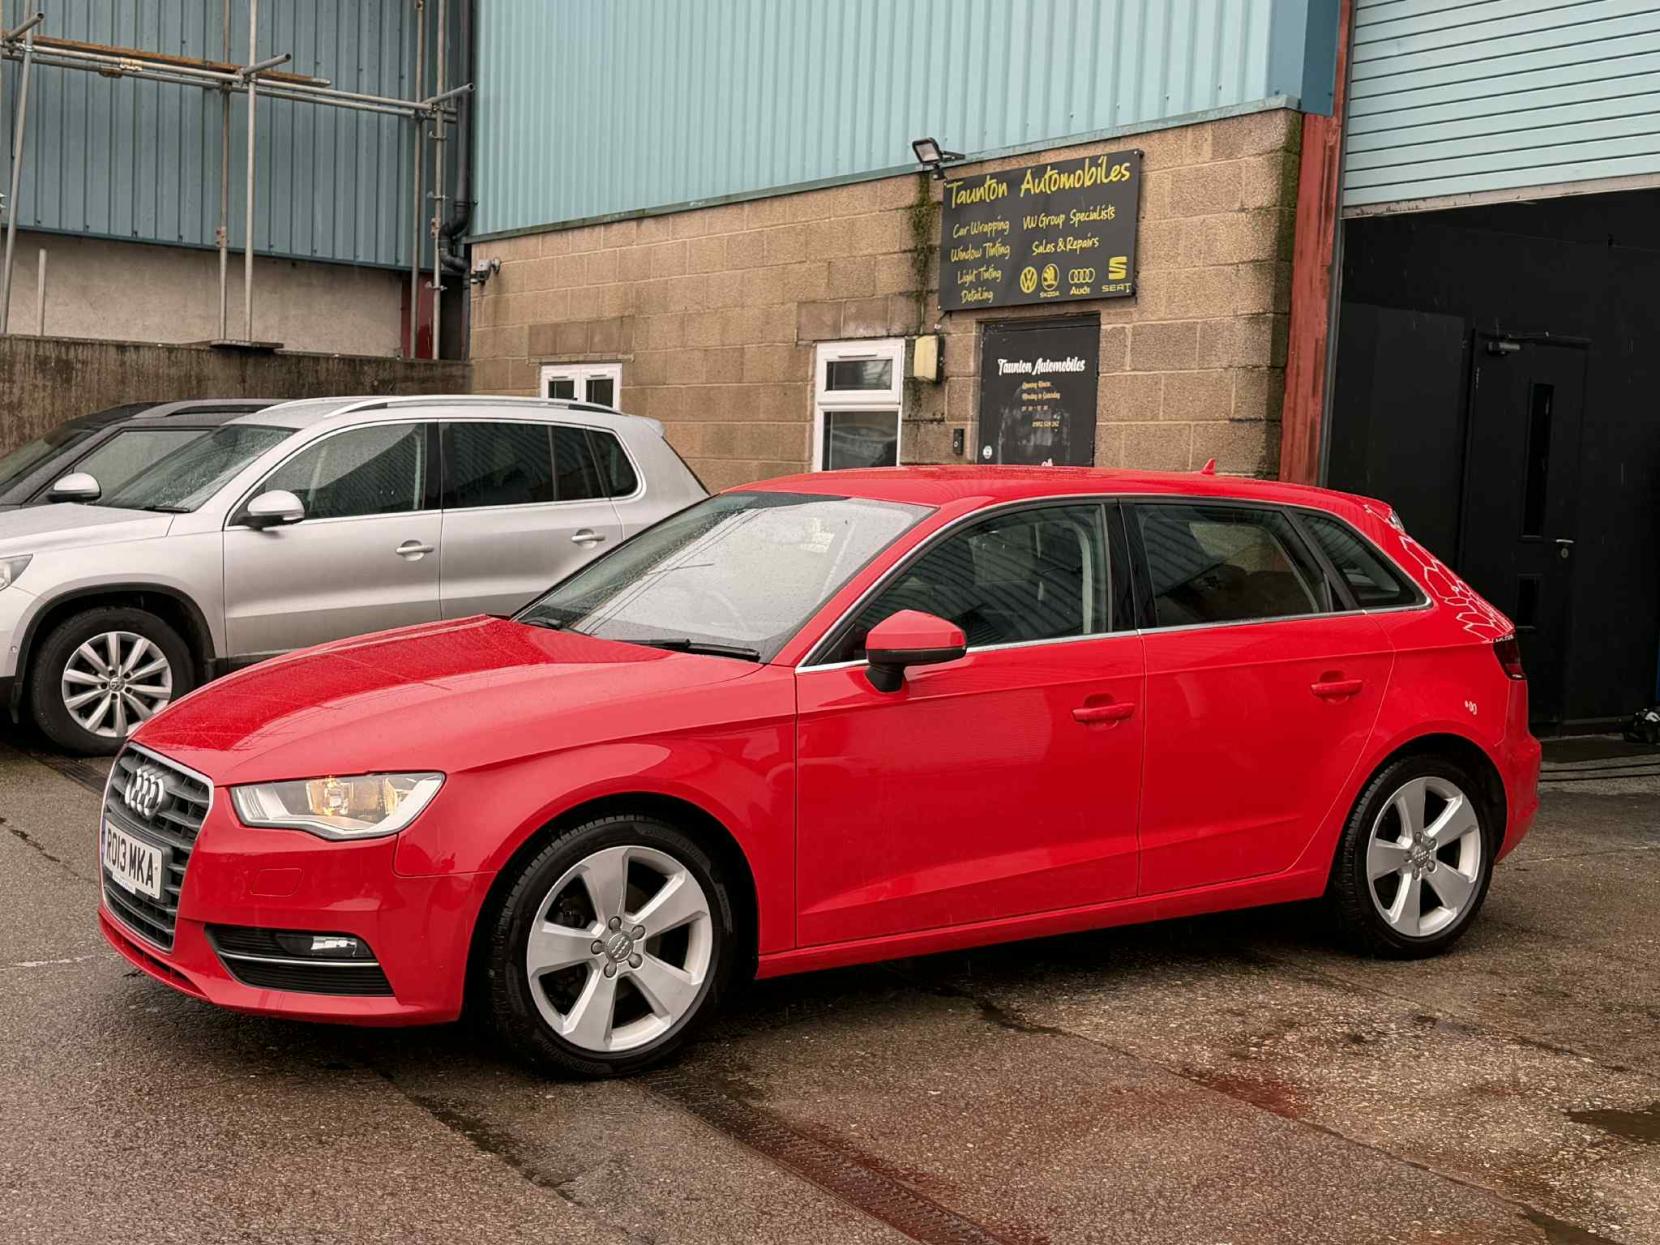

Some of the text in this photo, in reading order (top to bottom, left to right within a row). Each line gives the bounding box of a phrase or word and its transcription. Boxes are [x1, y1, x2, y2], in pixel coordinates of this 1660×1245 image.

[946, 156, 1131, 209] Taunton Automobiles
[953, 215, 1010, 239] Car Wrapping
[1038, 213, 1065, 229] Group
[1069, 204, 1115, 228] Specialists
[951, 238, 1011, 262] Window Tinting
[1032, 232, 1099, 256] Sales & Repairs
[957, 268, 978, 287] Light
[1101, 282, 1132, 293] SEAT
[1069, 285, 1091, 295] Audi
[1031, 356, 1086, 376] Automobiles
[128, 842, 154, 889] MKA
